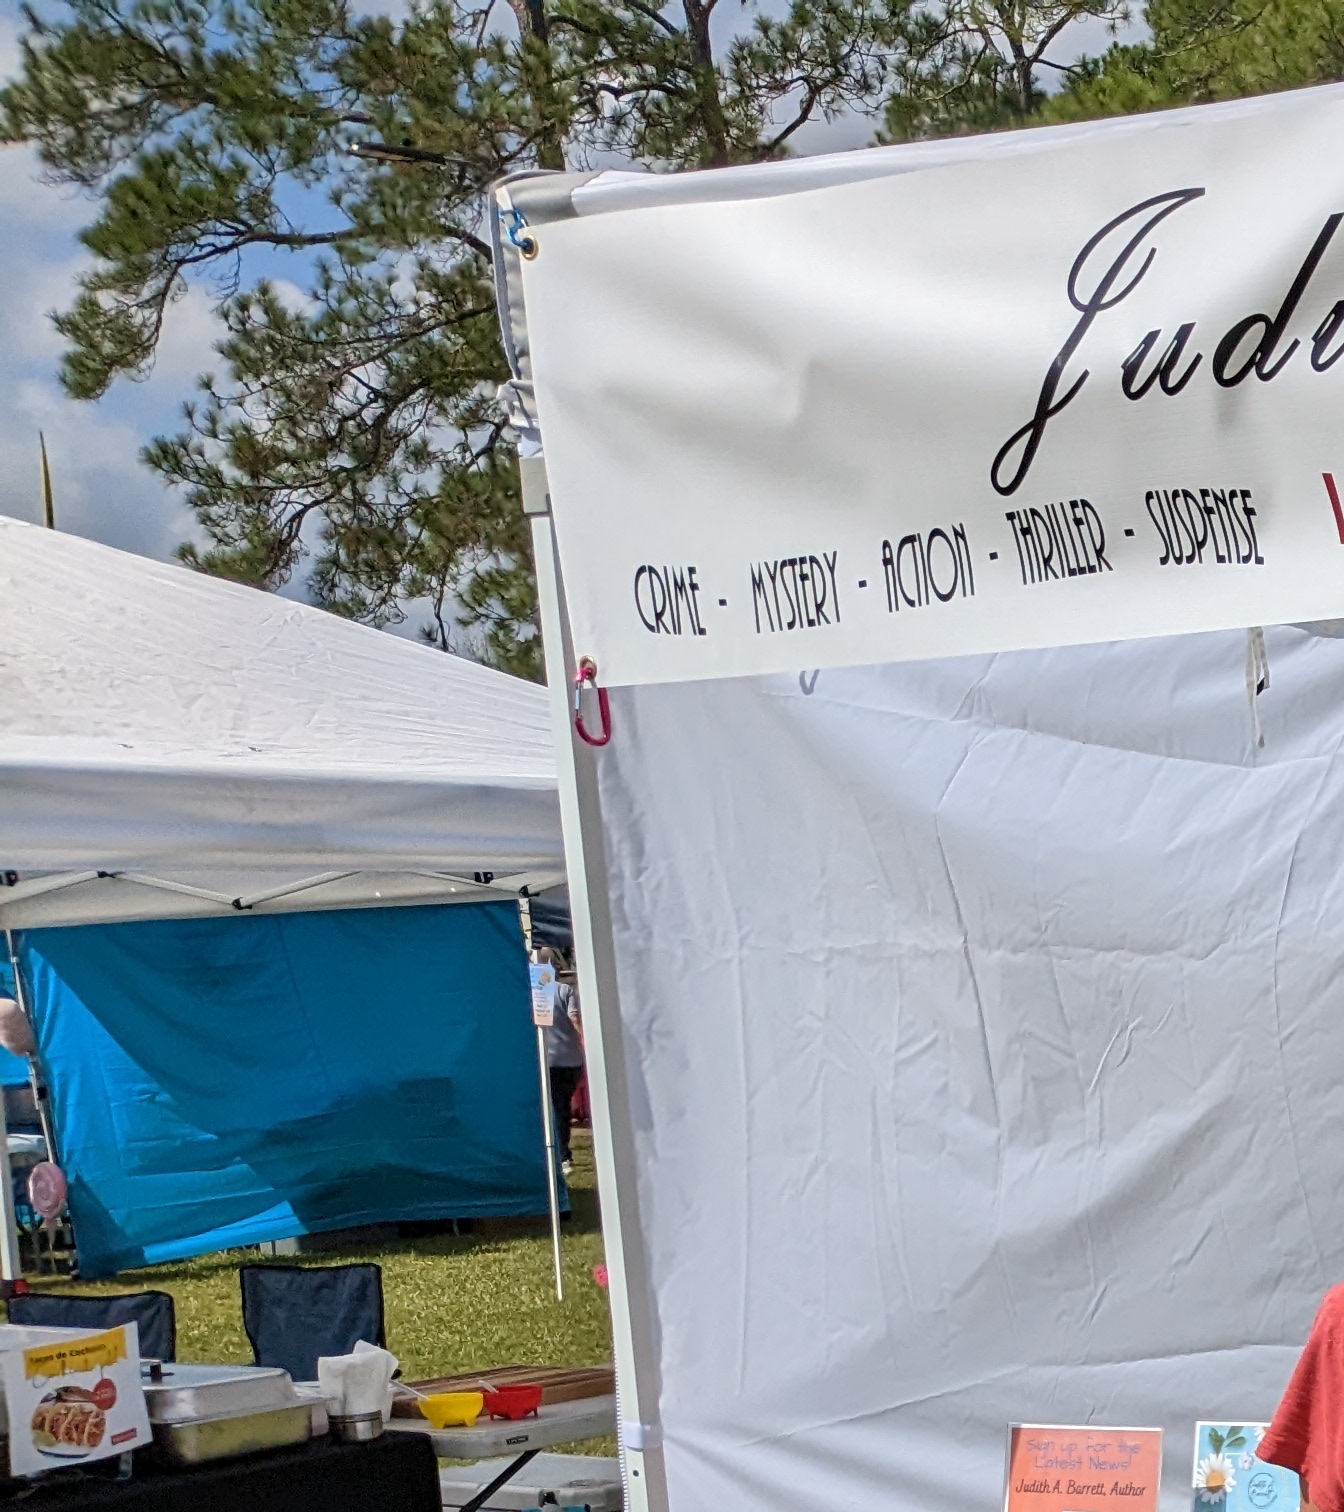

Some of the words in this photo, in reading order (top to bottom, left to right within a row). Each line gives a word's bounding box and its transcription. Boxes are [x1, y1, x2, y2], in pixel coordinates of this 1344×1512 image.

[633, 563, 706, 637] CRIME
[750, 548, 841, 635] MYSTERY
[881, 521, 976, 615] ACTION
[1004, 499, 1113, 588] THRILLER
[1144, 489, 1265, 569] SUSPENSE
[1035, 1457, 1082, 1469] Latest
[1016, 1479, 1050, 1494] Judith
[1052, 1480, 1062, 1493] A.
[1067, 1480, 1106, 1496] Barrett,
[1110, 1482, 1147, 1496] Author
